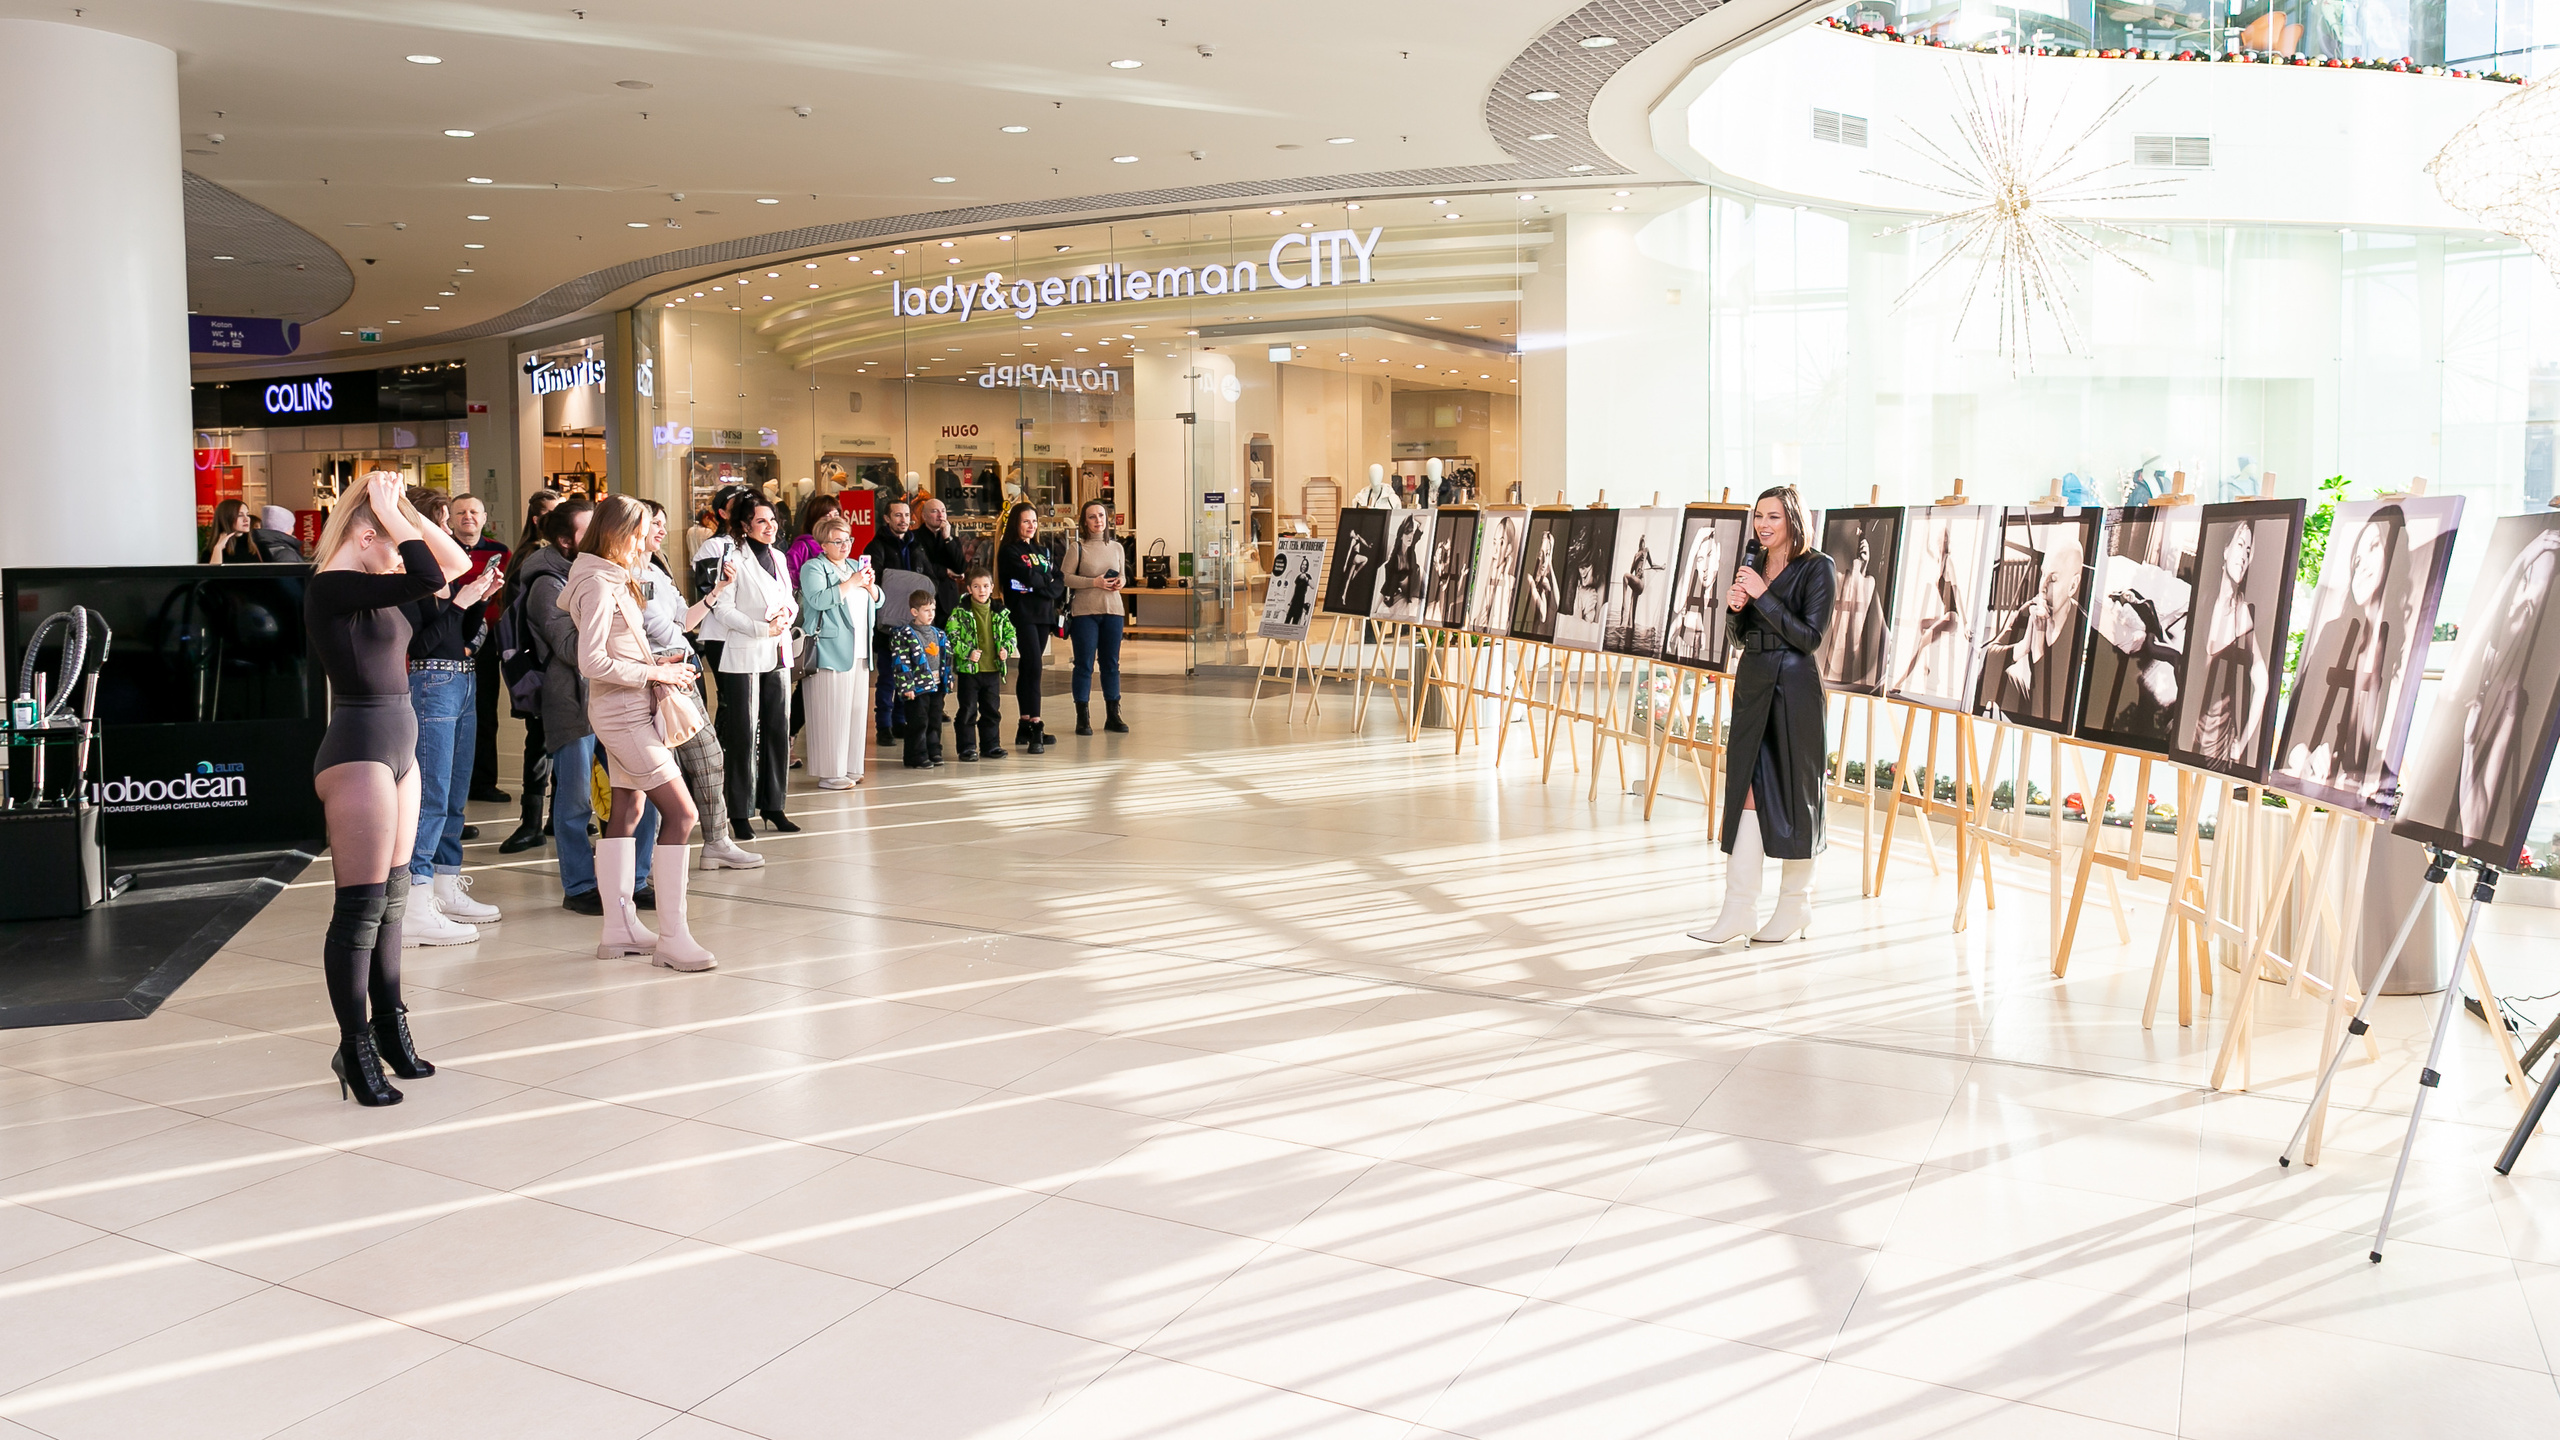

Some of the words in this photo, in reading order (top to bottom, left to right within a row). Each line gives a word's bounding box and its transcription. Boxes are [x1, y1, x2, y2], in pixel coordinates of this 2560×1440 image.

[893, 261, 1258, 322] lady&gentleman
[1268, 227, 1384, 289] CITY
[212, 340, 230, 348] Лифт
[265, 377, 333, 413] COLIN'S
[942, 424, 979, 437] HUGO
[947, 453, 973, 467] EA7
[945, 487, 978, 499] BOSS
[843, 509, 871, 525] SALE
[215, 762, 244, 773] aura
[92, 773, 247, 803] roboclean
[103, 804, 172, 813] ПОАЛЛЕРГЕННАЯ
[173, 802, 211, 810] СИСТЕМА
[212, 800, 248, 808] ОЧИСТКИ
